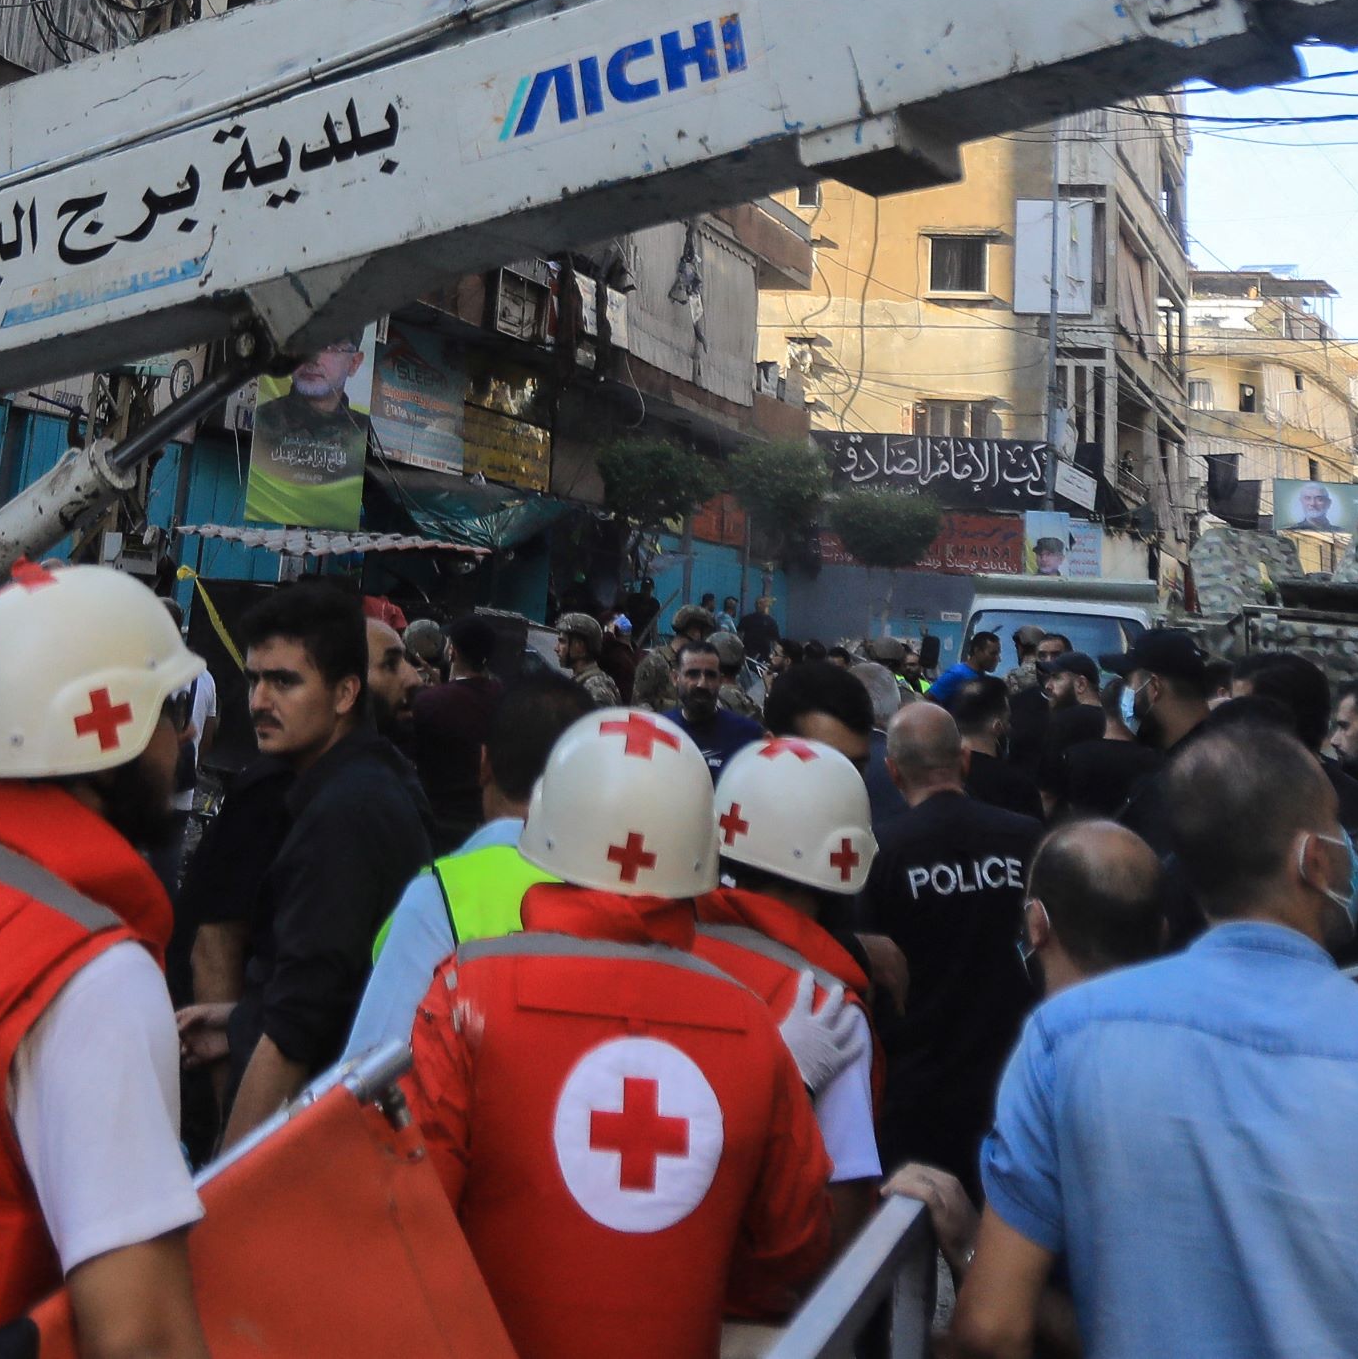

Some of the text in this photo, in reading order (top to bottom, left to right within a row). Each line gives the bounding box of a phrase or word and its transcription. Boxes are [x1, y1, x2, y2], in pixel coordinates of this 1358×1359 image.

[499, 13, 748, 141] AICHI
[214, 98, 402, 208] بلدية
[56, 164, 202, 264] برج
[908, 856, 1024, 900] POLICE
